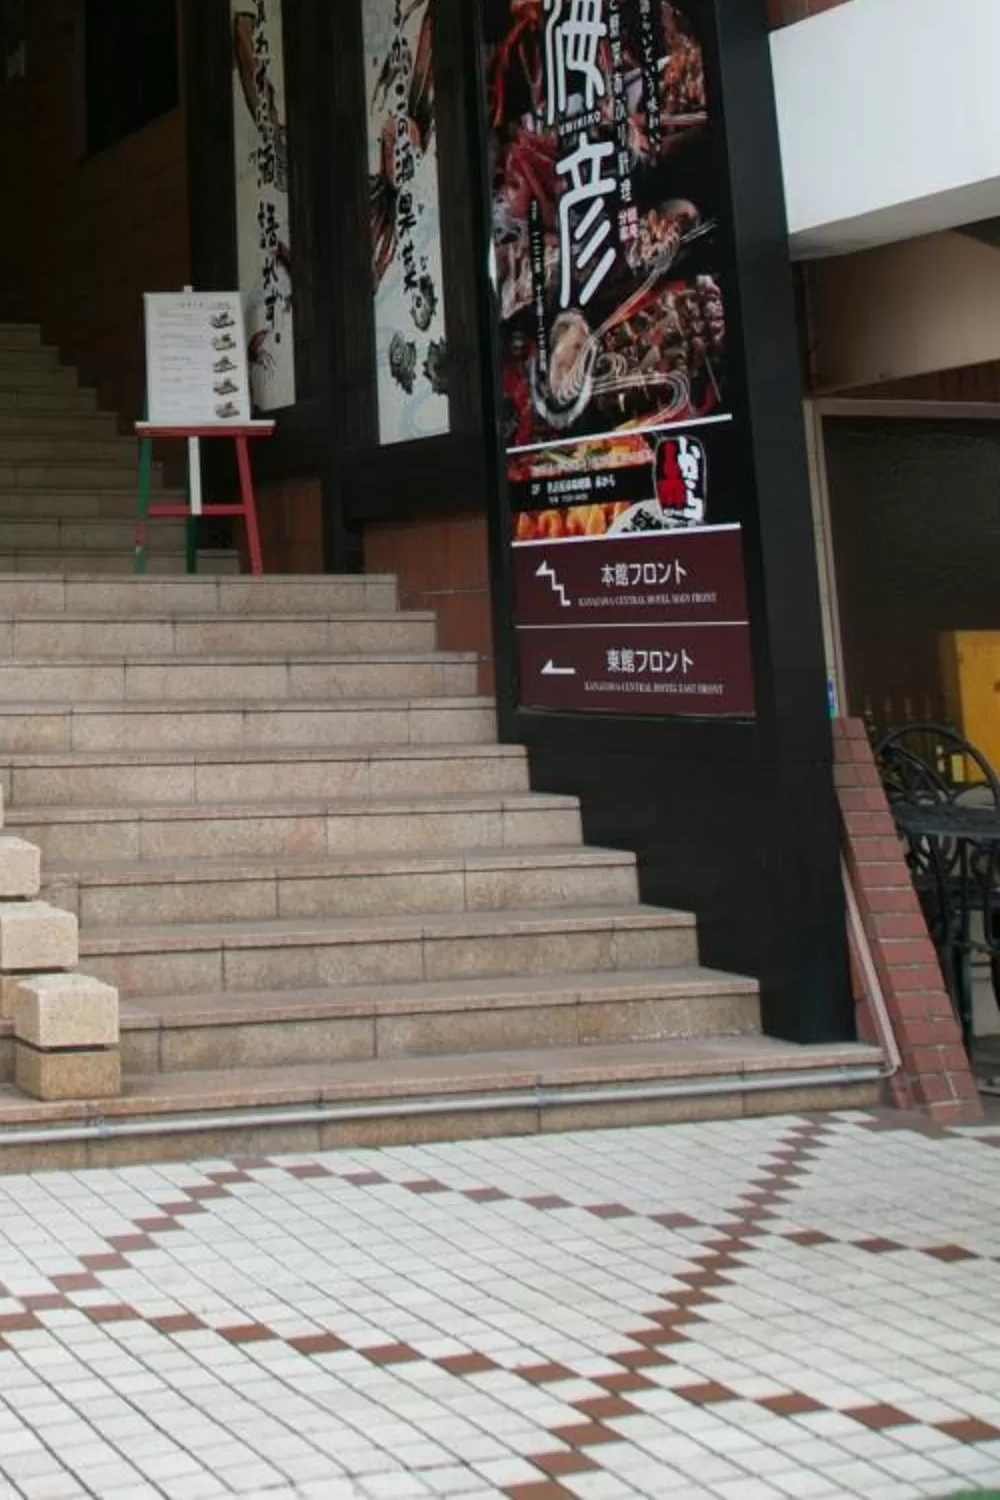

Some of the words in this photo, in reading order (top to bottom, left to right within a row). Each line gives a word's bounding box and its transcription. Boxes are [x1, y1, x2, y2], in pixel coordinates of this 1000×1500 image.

[601, 560, 688, 587] 本館フロント
